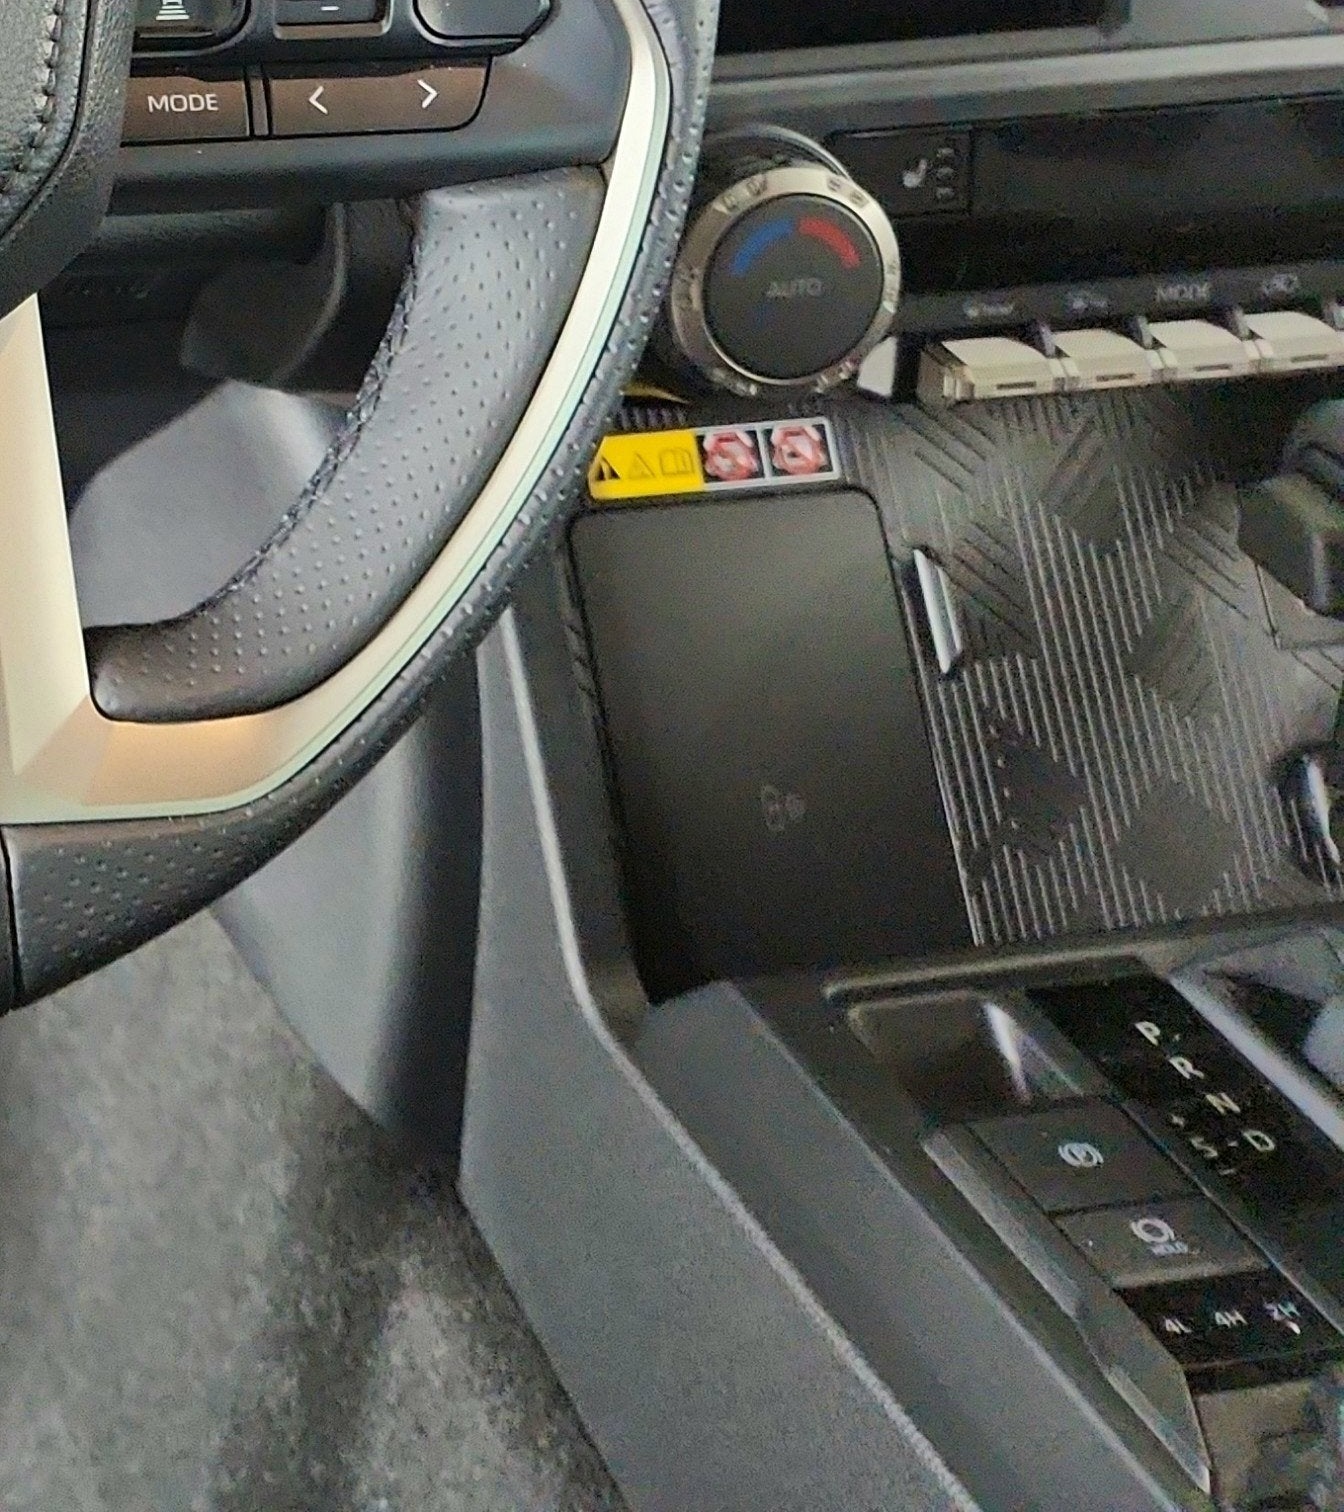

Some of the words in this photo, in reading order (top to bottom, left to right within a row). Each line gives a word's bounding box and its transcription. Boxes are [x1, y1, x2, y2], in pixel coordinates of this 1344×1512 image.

[147, 93, 219, 114] MODE
[1135, 1020, 1161, 1046] P
[1168, 1056, 1205, 1080] R
[1204, 1091, 1241, 1116] N
[1242, 1129, 1276, 1152] D
